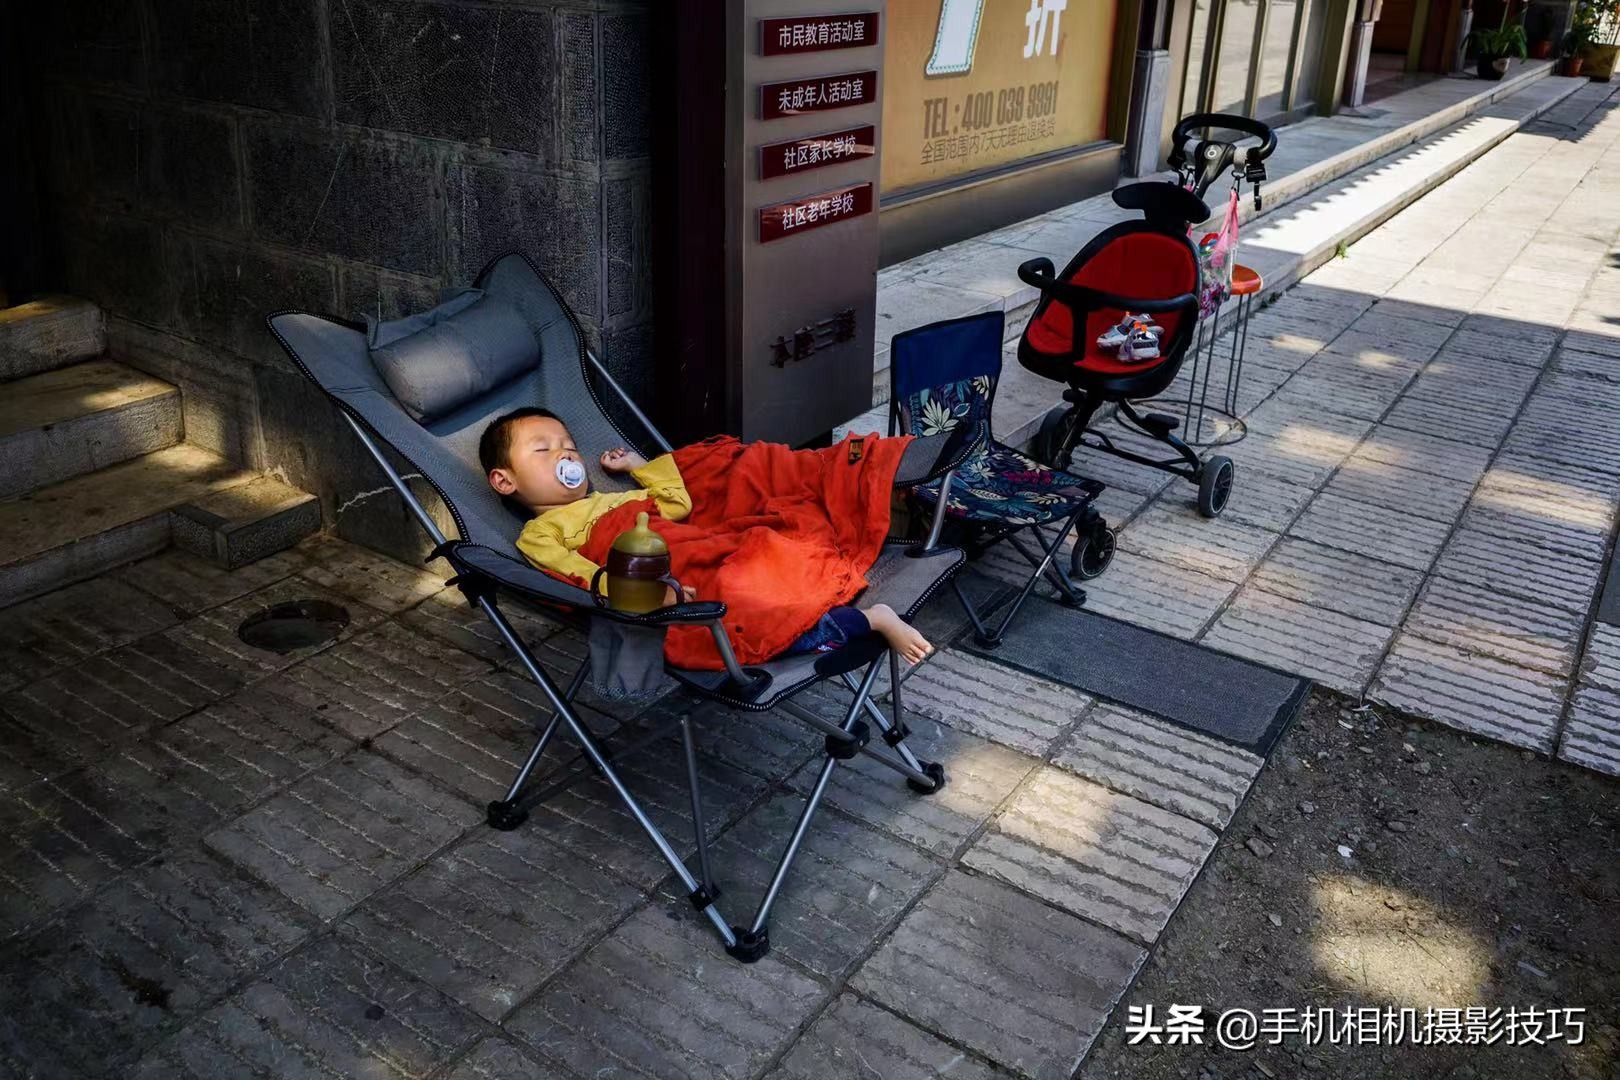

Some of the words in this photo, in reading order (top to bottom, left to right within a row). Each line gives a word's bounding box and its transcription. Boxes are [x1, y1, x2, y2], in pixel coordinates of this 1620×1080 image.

[779, 19, 865, 48] 市民教育活动室
[779, 79, 863, 111] 未成年人活动室
[784, 135, 856, 170] 社区家长学校
[782, 193, 854, 230] 社区老年学校
